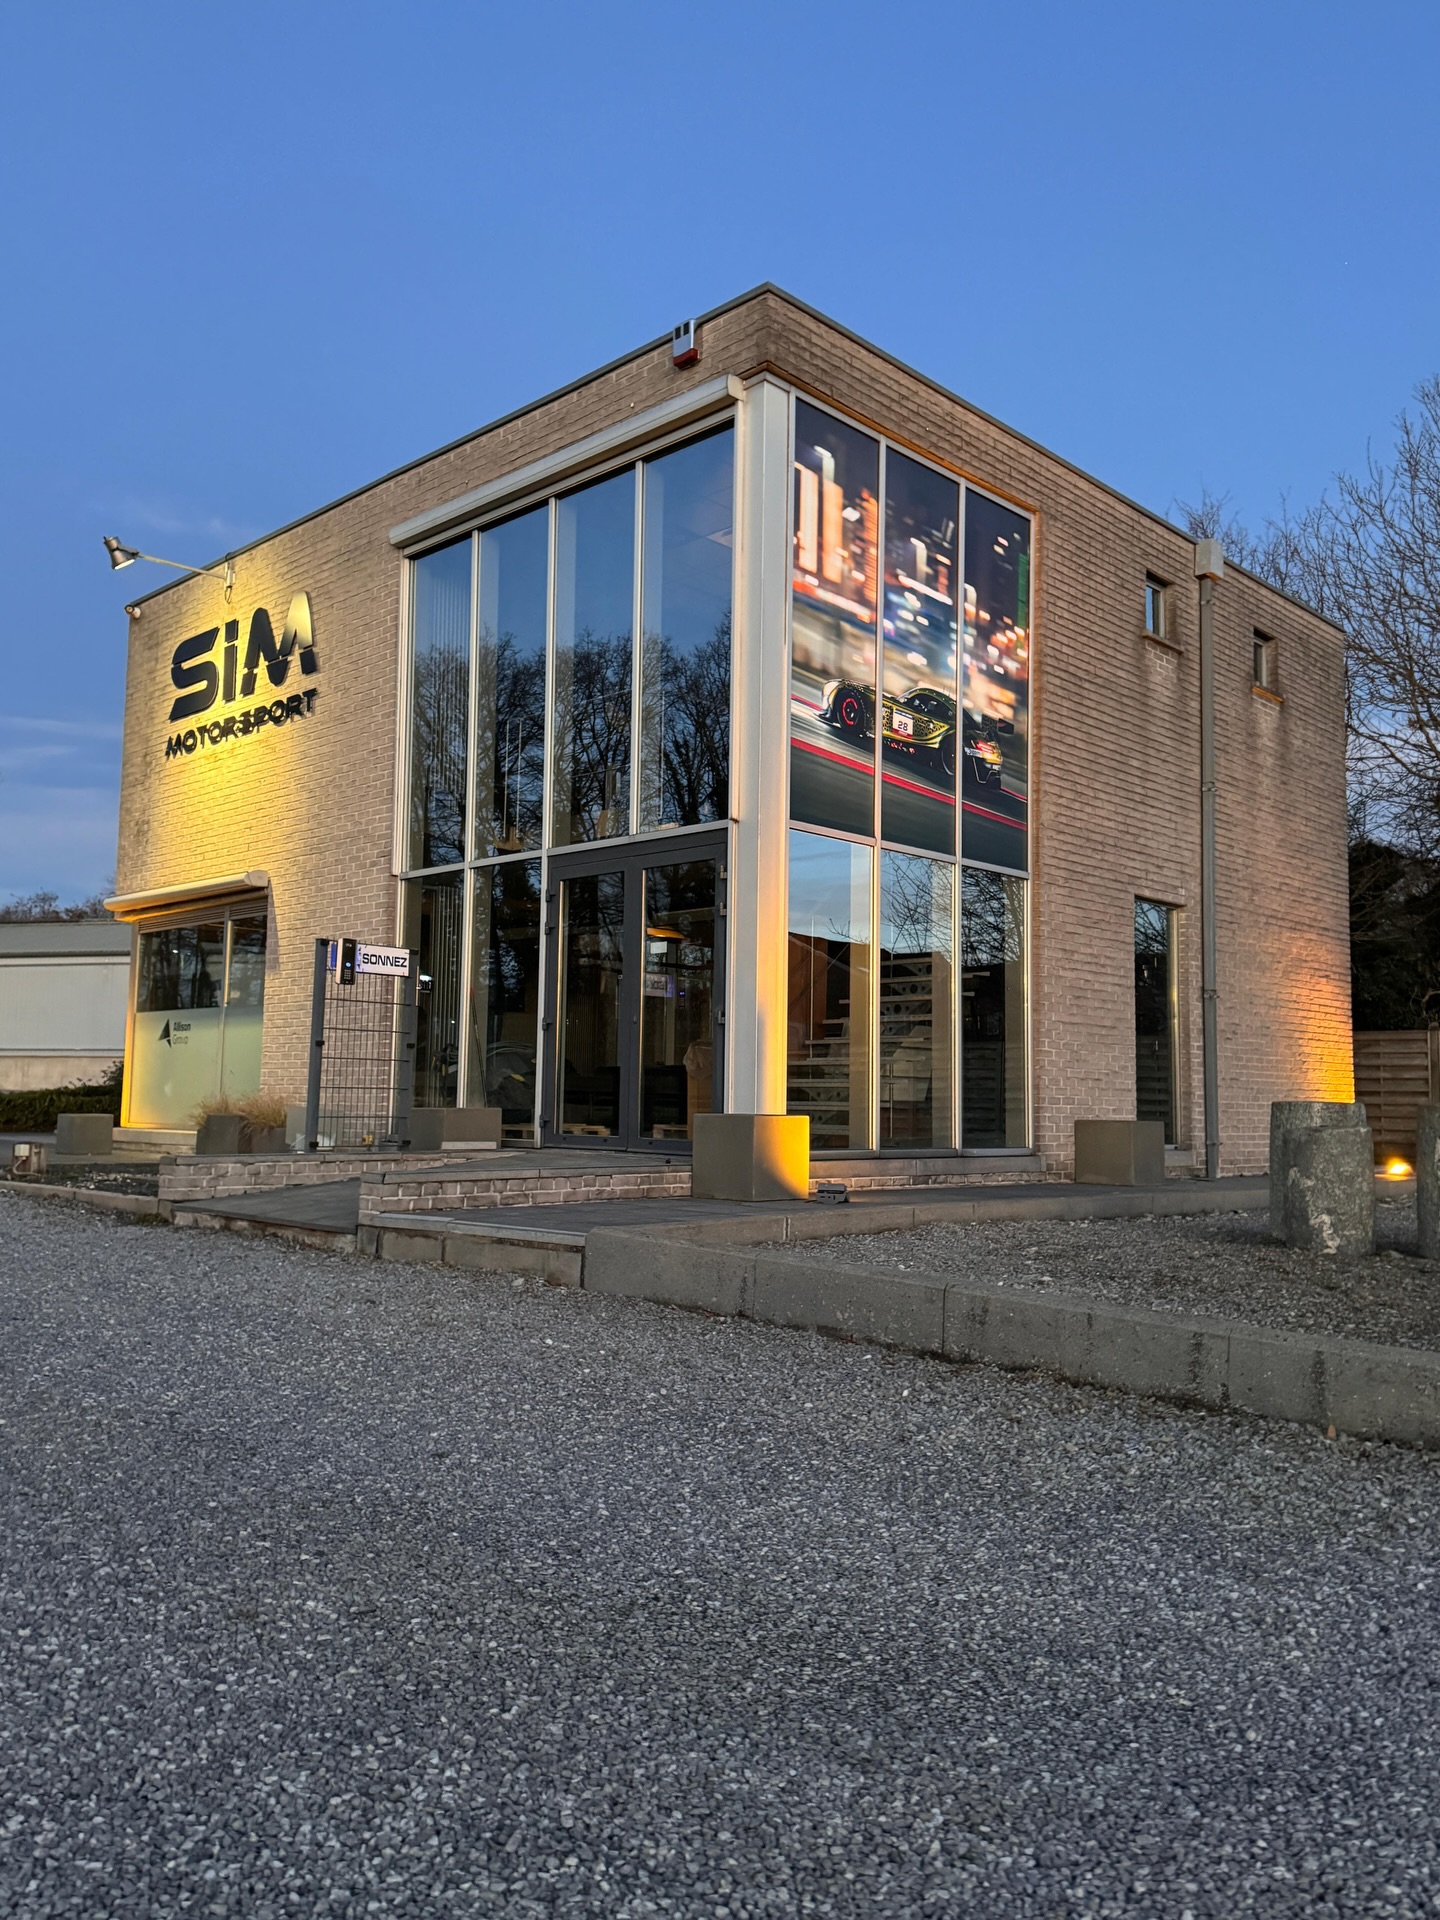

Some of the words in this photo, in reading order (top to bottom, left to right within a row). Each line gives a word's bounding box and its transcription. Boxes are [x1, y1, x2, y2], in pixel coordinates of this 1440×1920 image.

[165, 688, 318, 760] MOTORSPORT
[898, 721, 909, 731] 28
[362, 953, 408, 968] SONNEZ
